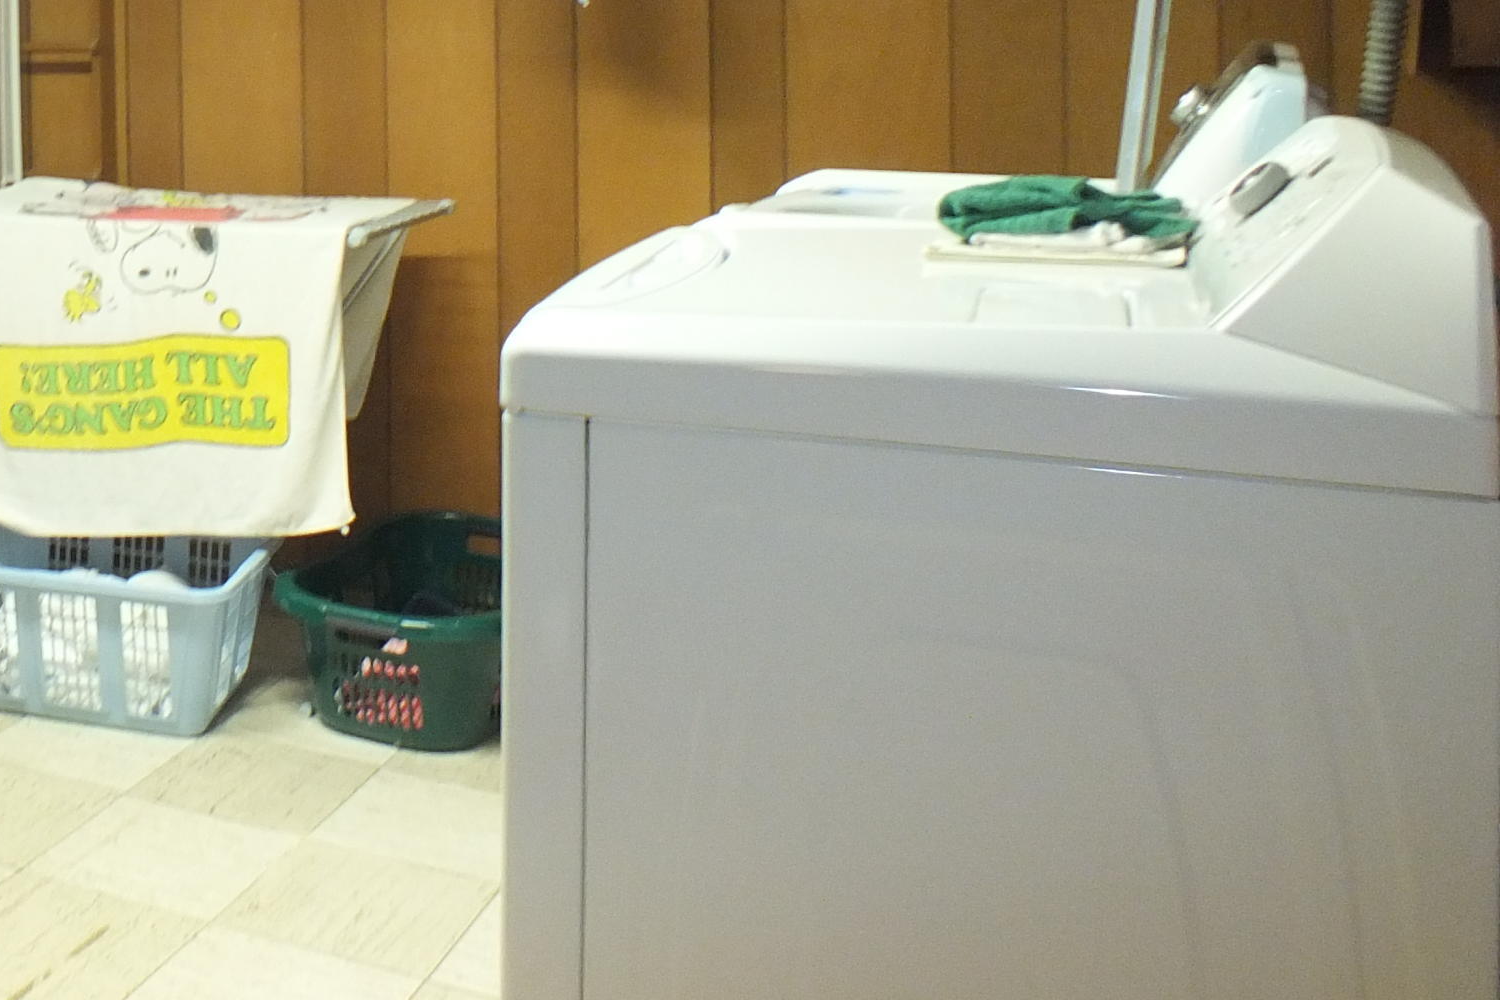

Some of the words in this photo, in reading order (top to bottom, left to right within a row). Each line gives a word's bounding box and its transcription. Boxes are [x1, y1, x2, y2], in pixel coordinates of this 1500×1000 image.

[19, 354, 157, 396] HERE!
[164, 350, 258, 388] ALL
[9, 396, 168, 436] GANG'S
[176, 392, 277, 431] THE
